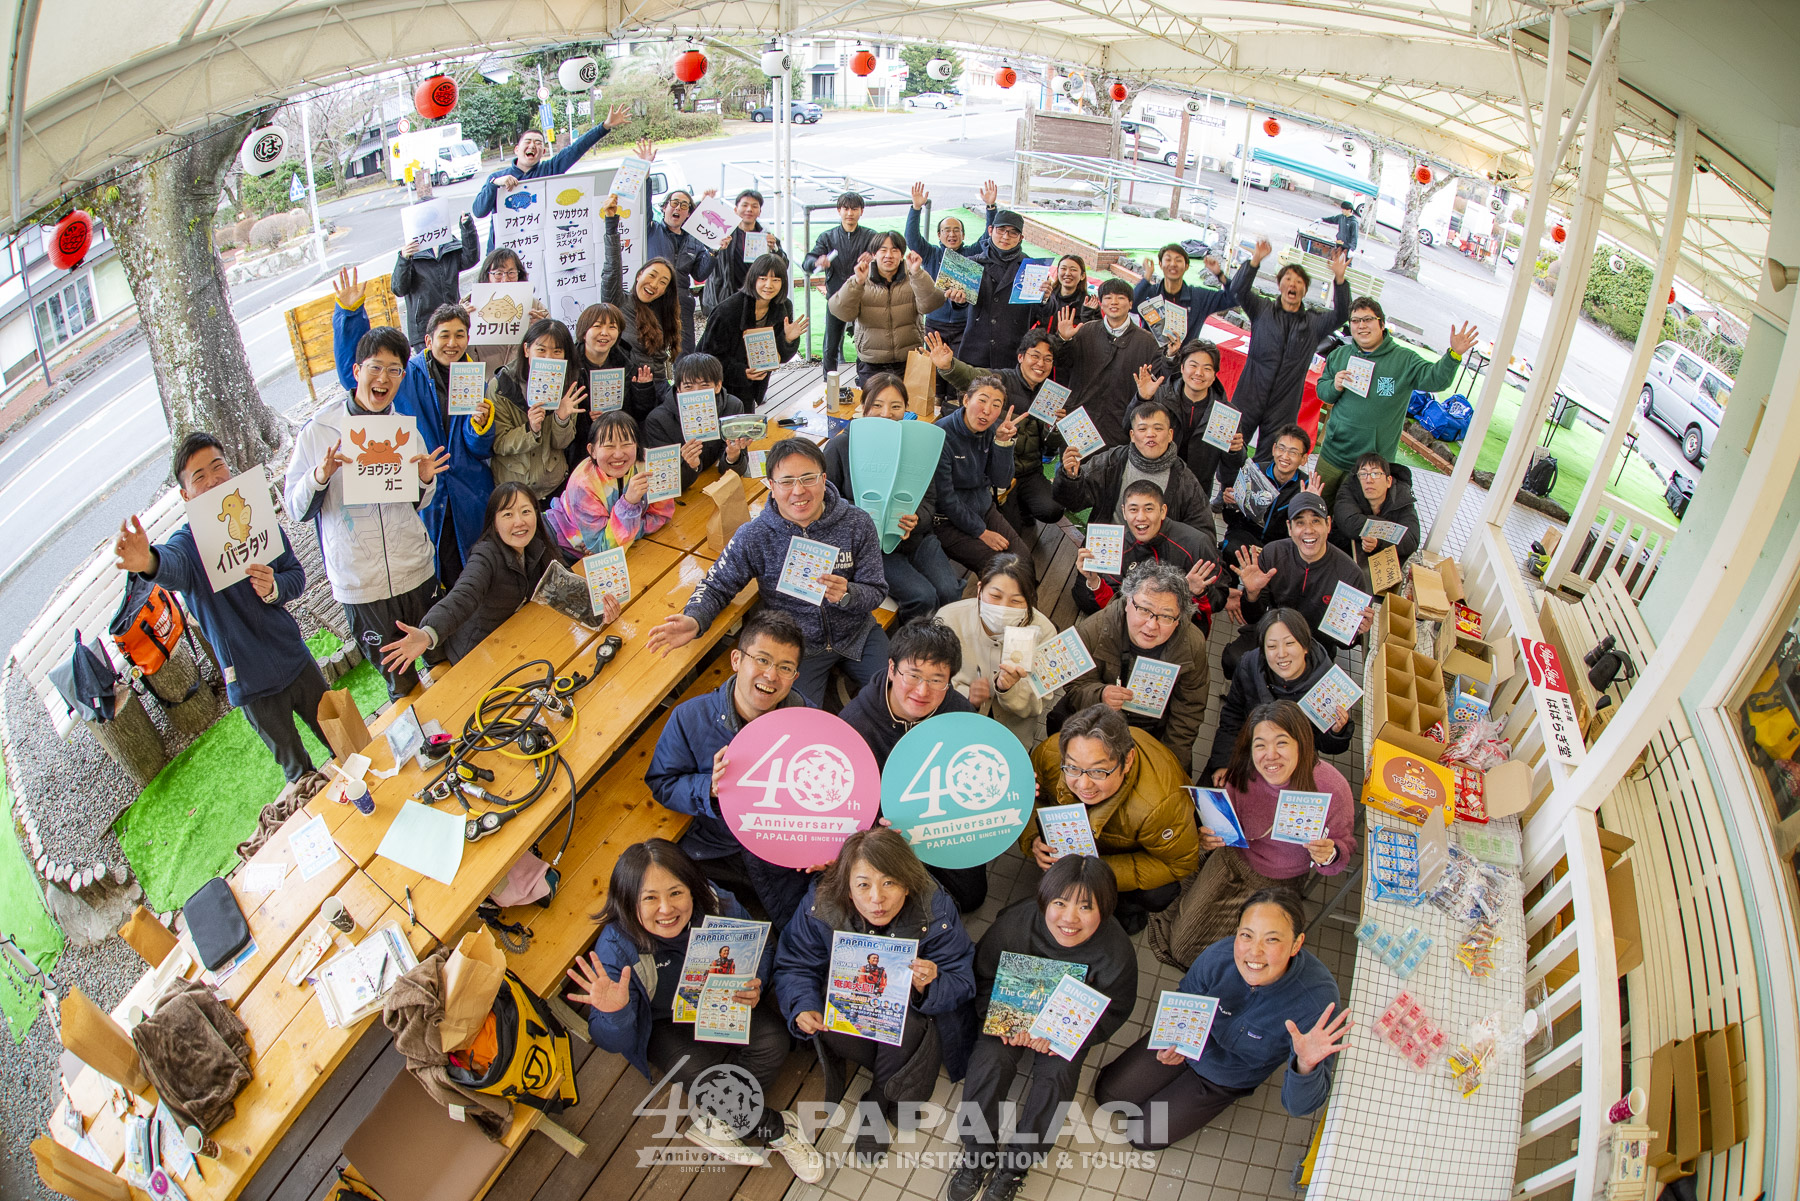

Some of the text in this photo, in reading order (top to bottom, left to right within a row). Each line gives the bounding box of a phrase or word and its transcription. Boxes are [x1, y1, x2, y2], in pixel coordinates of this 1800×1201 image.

[552, 208, 589, 220] マツカサウオ
[502, 234, 540, 250] アオヤガラ
[559, 250, 586, 265] サザエ
[556, 273, 587, 287] ガンガゼ
[476, 321, 521, 336] カワハギ
[534, 362, 562, 371] BINGYO
[682, 394, 710, 404] BINGYO
[1216, 405, 1237, 419] BINGYO
[650, 450, 676, 460] BINGYO
[357, 463, 402, 476] ショウジン
[384, 478, 403, 491] ガニ
[1091, 528, 1119, 536] BINGYO
[216, 529, 268, 574] イバラタツ
[796, 542, 832, 558] BINGYO
[589, 554, 619, 569] BINGYO
[1340, 587, 1365, 604] BINGYO
[1063, 635, 1087, 667] BINGYO
[1139, 662, 1172, 675] BINGYO
[1331, 672, 1356, 696] BINGYO
[1286, 795, 1323, 804] BINGYO
[753, 816, 844, 830] Anniversary
[1045, 811, 1080, 821] BINGYO
[922, 815, 1007, 837] Anniversary
[756, 832, 808, 842] PAPALAGI
[926, 834, 976, 849] PAPALAGI
[979, 831, 997, 839] SINCE
[885, 943, 912, 953] TIMES
[834, 979, 875, 994] 奄美大島!
[999, 986, 1015, 996] The
[1017, 989, 1040, 1000] Coral
[1064, 983, 1100, 1008] BINGYO
[1167, 998, 1209, 1010] BINGYO
